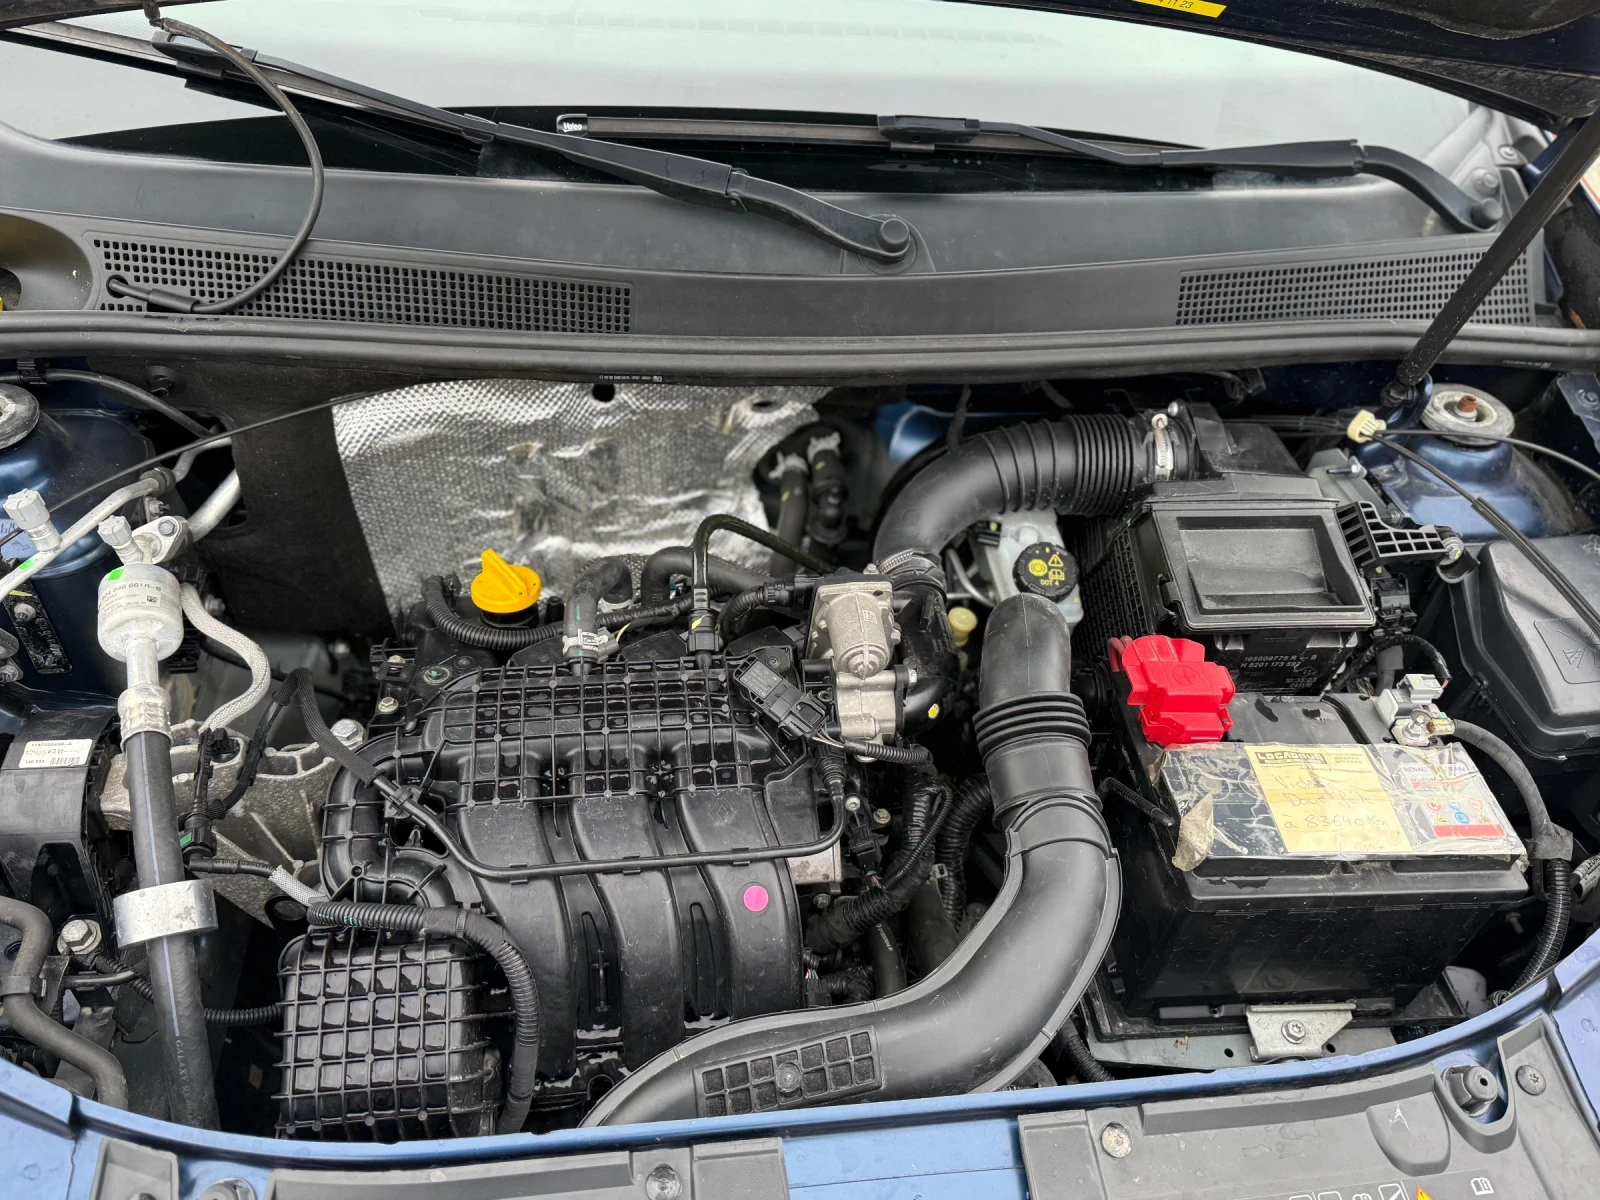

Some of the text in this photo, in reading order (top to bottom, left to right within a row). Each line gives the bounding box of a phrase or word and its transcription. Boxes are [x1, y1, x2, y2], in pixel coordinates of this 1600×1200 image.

[1179, 0, 1193, 9] 23
[562, 121, 582, 132] Valeo
[1304, 814, 1365, 828] 83640
[175, 1039, 189, 1082] GALAXY
